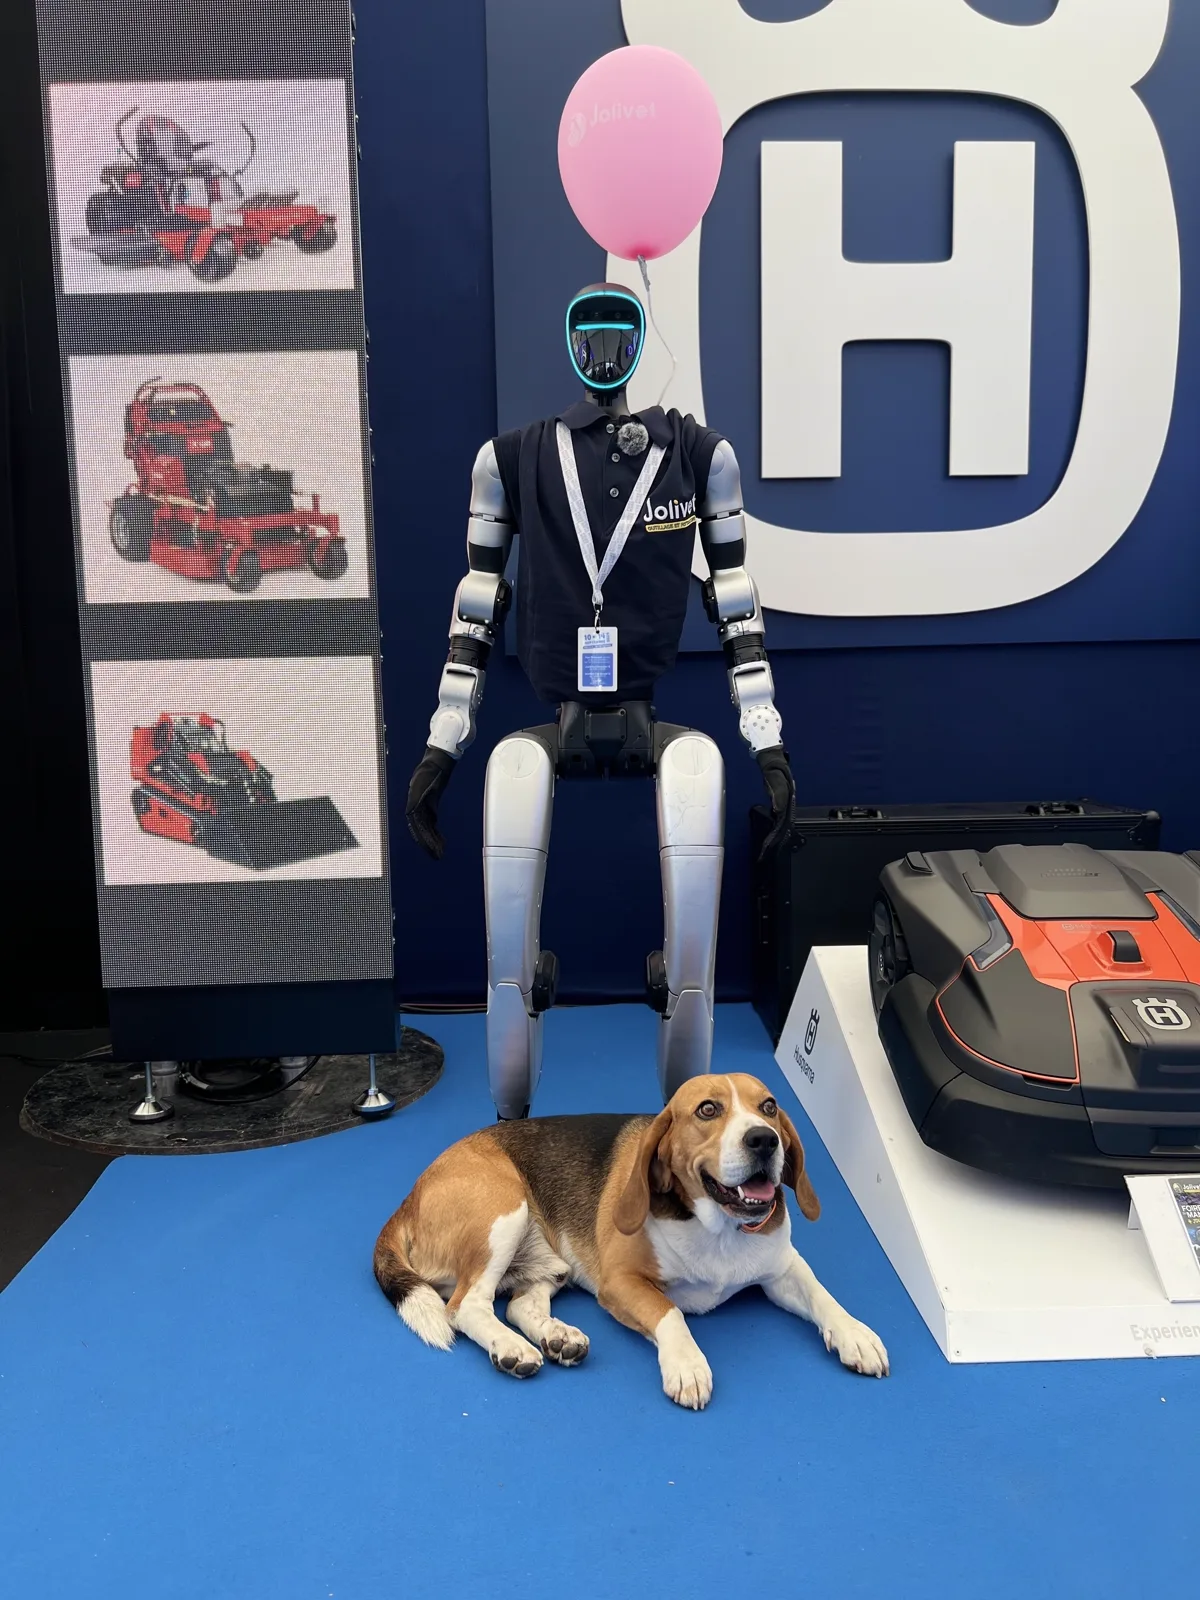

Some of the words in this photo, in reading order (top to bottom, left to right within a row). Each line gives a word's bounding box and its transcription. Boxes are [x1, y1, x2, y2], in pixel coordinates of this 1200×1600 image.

[589, 101, 657, 128] Jolivet
[643, 493, 696, 522] Jolivet
[794, 1044, 815, 1085] Husqvarna
